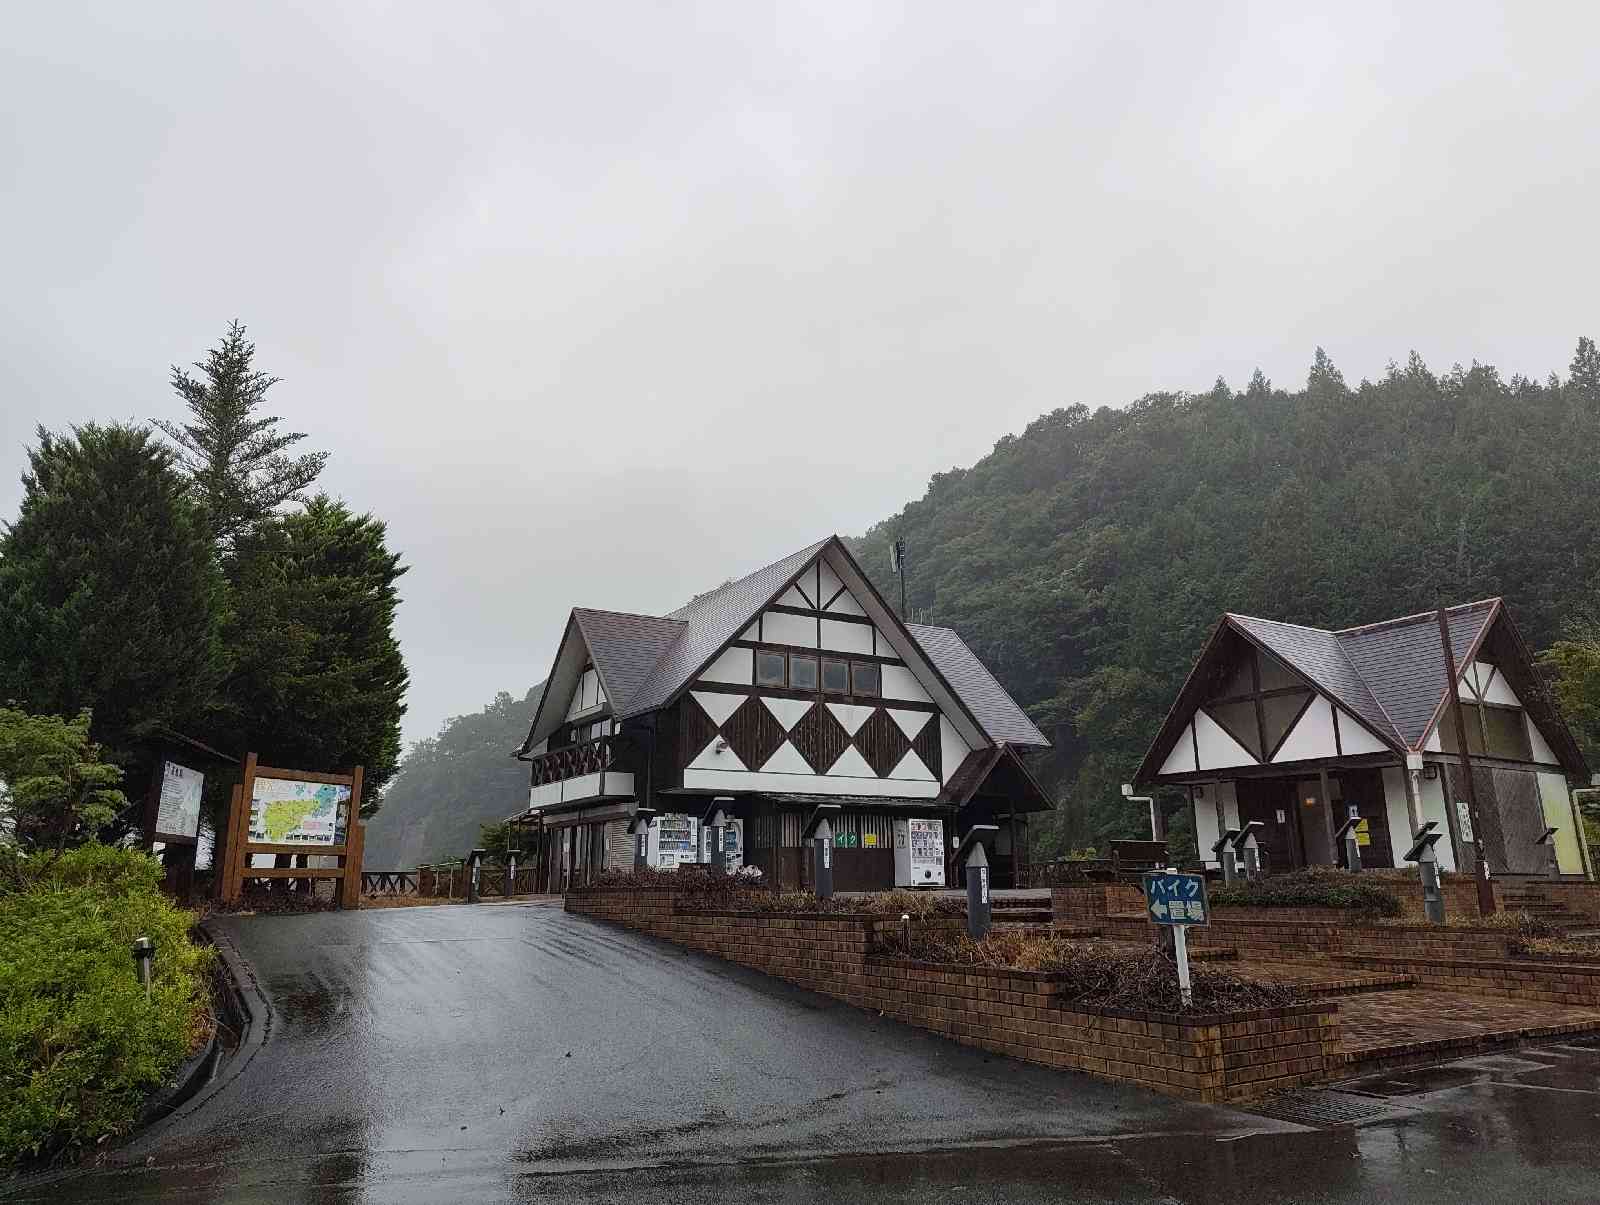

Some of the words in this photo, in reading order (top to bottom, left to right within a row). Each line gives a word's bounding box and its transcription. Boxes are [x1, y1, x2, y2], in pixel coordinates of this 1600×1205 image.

[1151, 879, 1199, 897] バイク
[1168, 900, 1204, 921] 置場
